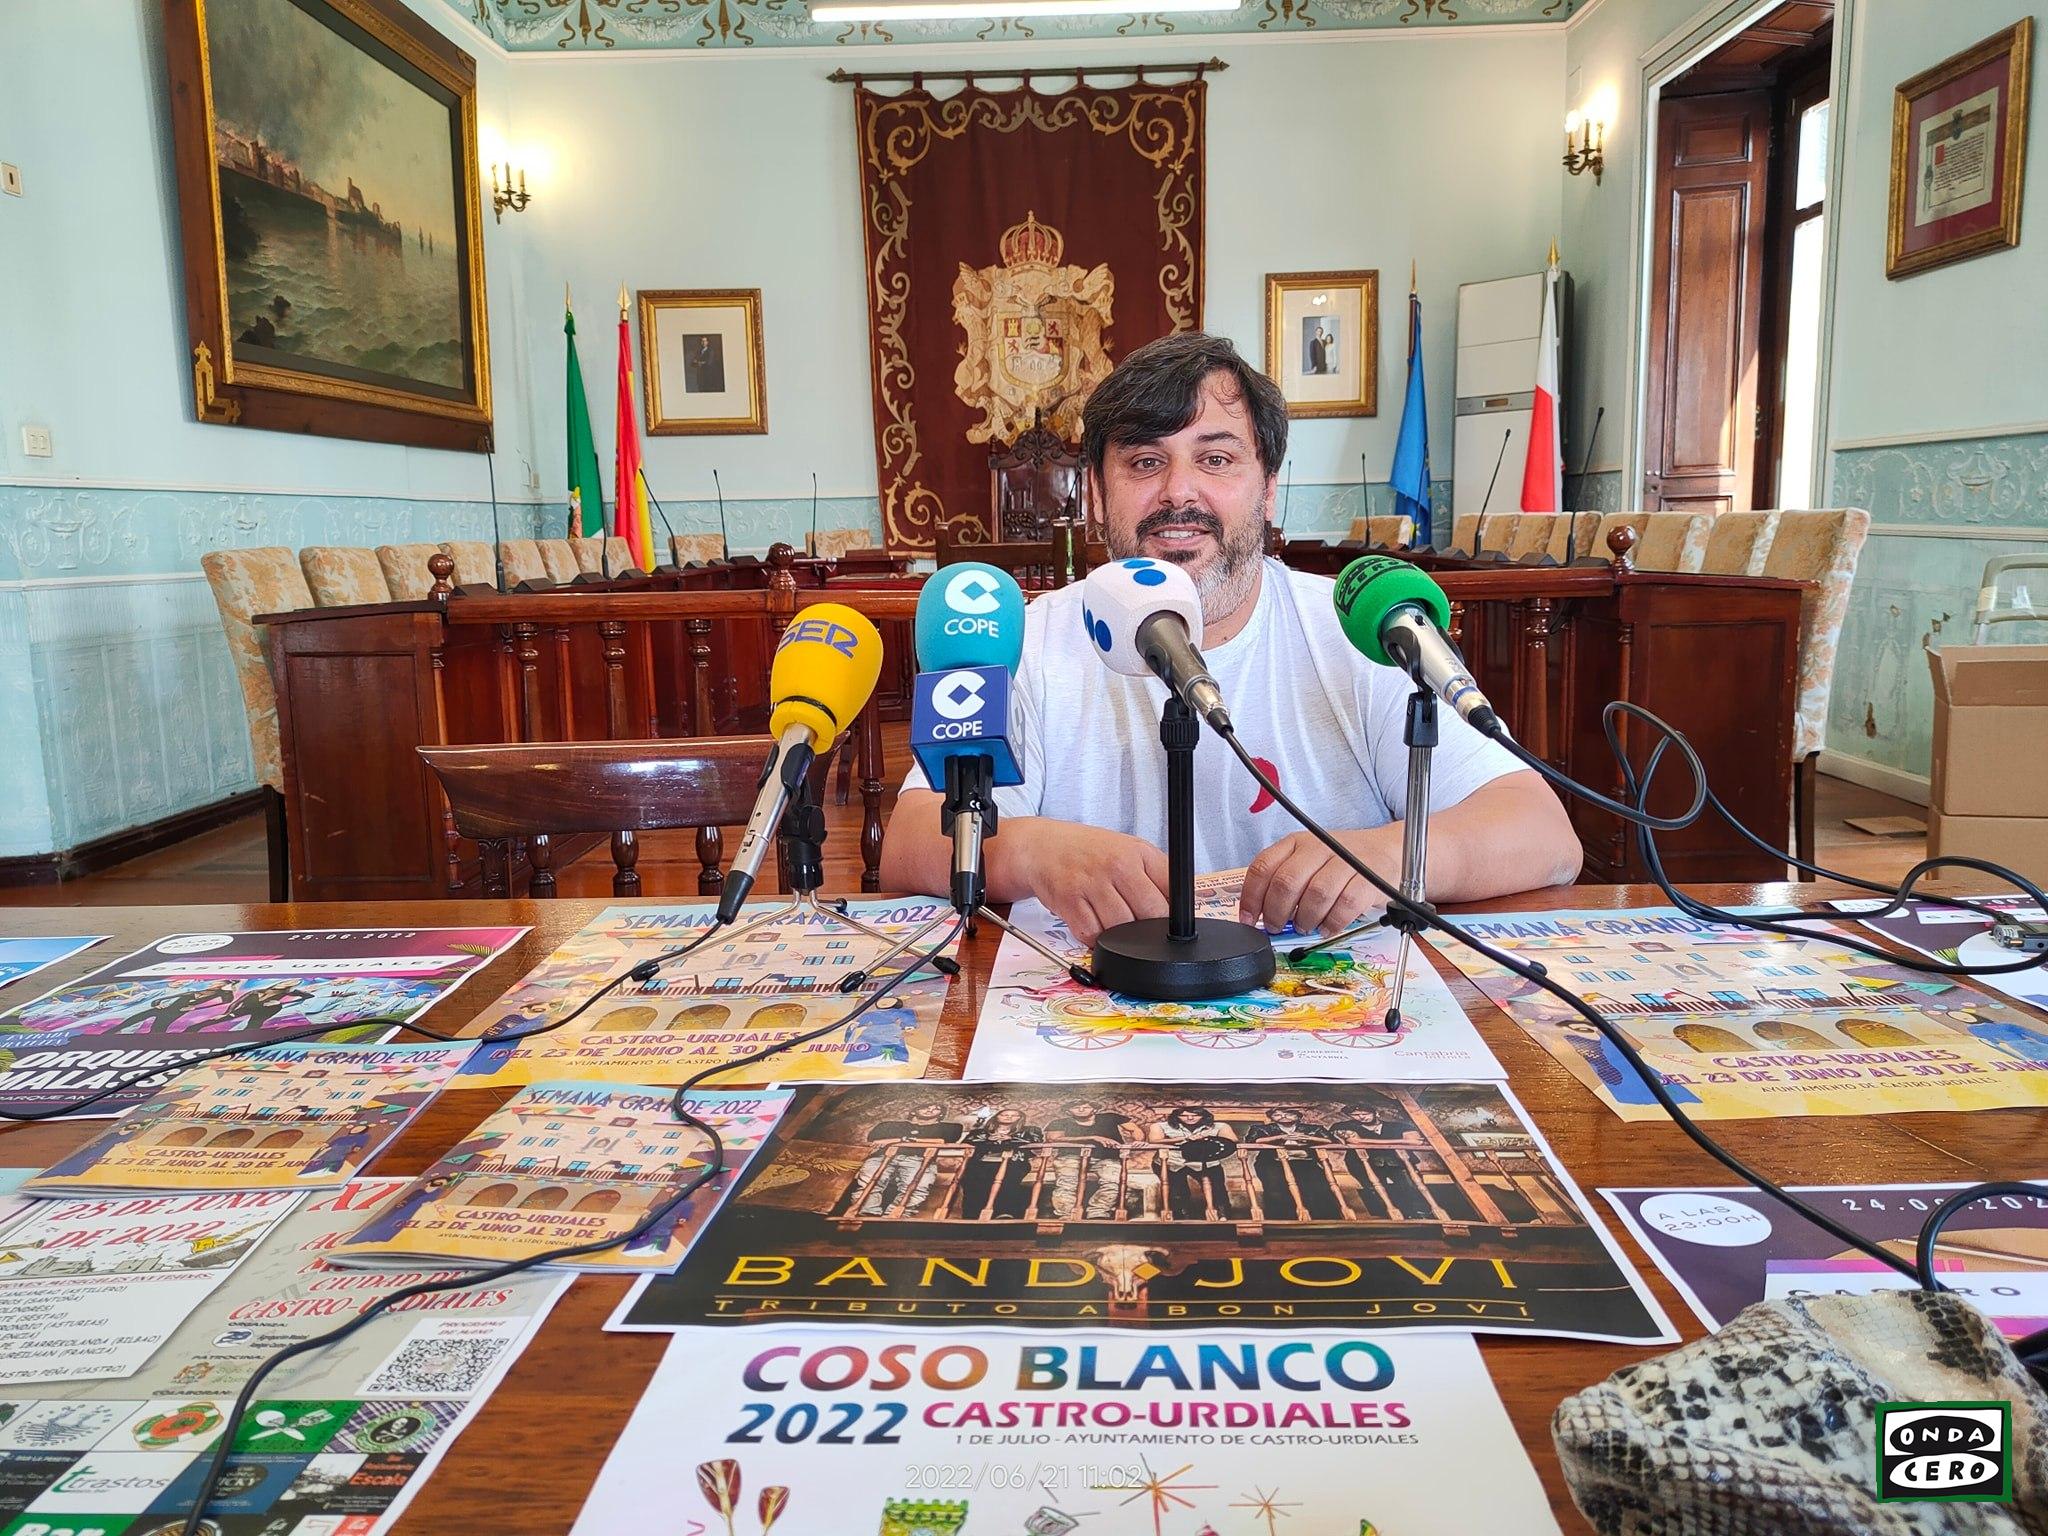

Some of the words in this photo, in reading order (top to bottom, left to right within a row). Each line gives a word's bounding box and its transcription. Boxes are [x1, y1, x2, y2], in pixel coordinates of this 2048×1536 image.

[944, 618, 999, 638] COPE
[777, 620, 859, 659] SER
[932, 720, 983, 740] COPE
[614, 912, 719, 930] SEMAN
[873, 905, 939, 924] 2022
[1459, 920, 1585, 939] EMANA
[1585, 915, 1724, 935] GRANDE
[151, 963, 273, 972] CASTRO
[291, 960, 447, 969] URDIALES
[580, 1031, 801, 1046] CASTRO-URDIALES
[10, 1049, 228, 1068] ORQUES
[221, 1050, 308, 1064] SEMANA
[313, 1051, 401, 1065] GRANDE
[400, 1049, 450, 1063] 2022
[489, 1049, 532, 1060] DEL
[539, 1048, 568, 1058] 23
[574, 1047, 605, 1058] DE
[613, 1045, 685, 1057] JUNIO
[688, 1045, 721, 1055] AL
[728, 1044, 758, 1054] 30
[802, 1043, 872, 1053] JUNIO
[1712, 1048, 1961, 1070] CASTRO-URDIALES
[1741, 1068, 1774, 1083] DE
[1788, 1066, 1862, 1081] JUNIO
[1867, 1064, 1901, 1078] AL
[1905, 1063, 1939, 1077] 30
[1949, 1061, 1979, 1075] DE
[1761, 1083, 1858, 1094] AYUNTAMIENTO
[1860, 1082, 1878, 1091] DE
[1880, 1080, 1932, 1090] CASTRO
[521, 1088, 613, 1108] SEMANA
[618, 1094, 709, 1115] GRANDE
[710, 1099, 763, 1116] 2022
[115, 1157, 139, 1166] 23
[141, 1158, 160, 1166] DE
[159, 1158, 207, 1168] JUNIO
[211, 1159, 232, 1168] AL
[233, 1160, 254, 1169] 30
[256, 1160, 280, 1169] DE
[145, 1148, 288, 1160] CASTRO-URDIALES
[110, 1198, 173, 1218] DE
[165, 1190, 291, 1215] JUNIO
[1658, 1212, 1676, 1220] A
[1684, 1205, 1731, 1218] LAS
[455, 1209, 608, 1228] CASTRO-URDIALES
[1664, 1213, 1760, 1232] 23:00H
[41, 1227, 116, 1250] DE
[103, 1220, 227, 1246] 2022
[423, 1219, 446, 1230] 23
[448, 1220, 472, 1231] DE
[473, 1222, 522, 1235] JUNIO
[524, 1225, 545, 1236] AL
[554, 1226, 573, 1237] 30
[575, 1228, 596, 1239] DE
[723, 1256, 1098, 1287] BAND
[1194, 1255, 1518, 1288] JOVI
[309, 1273, 422, 1293] CIUDAD
[229, 1289, 514, 1321] CASTRO-UDIALES
[715, 1299, 1018, 1315] TRIBUTO
[1077, 1304, 1099, 1315] A
[1168, 1303, 1295, 1316] BON
[1366, 1302, 1529, 1317] JOVI
[111, 1335, 161, 1346] (BILBAO)
[59, 1346, 118, 1358] (FRANCIA)
[71, 1364, 126, 1376] (CASTRO)
[742, 1345, 989, 1393] COSO
[1014, 1341, 1396, 1392] BLANCO
[724, 1402, 909, 1445] 2022
[922, 1401, 1412, 1429] CASTRO-URDIALES
[956, 1434, 963, 1445] 1
[968, 1434, 994, 1445] DE
[997, 1434, 1051, 1446] JULIO
[1064, 1434, 1215, 1446] AYUNTAMIENTO
[1220, 1434, 1246, 1445] DE
[1250, 1434, 1419, 1446] CASTRO-URDIALES
[68, 1477, 171, 1489] trastos
